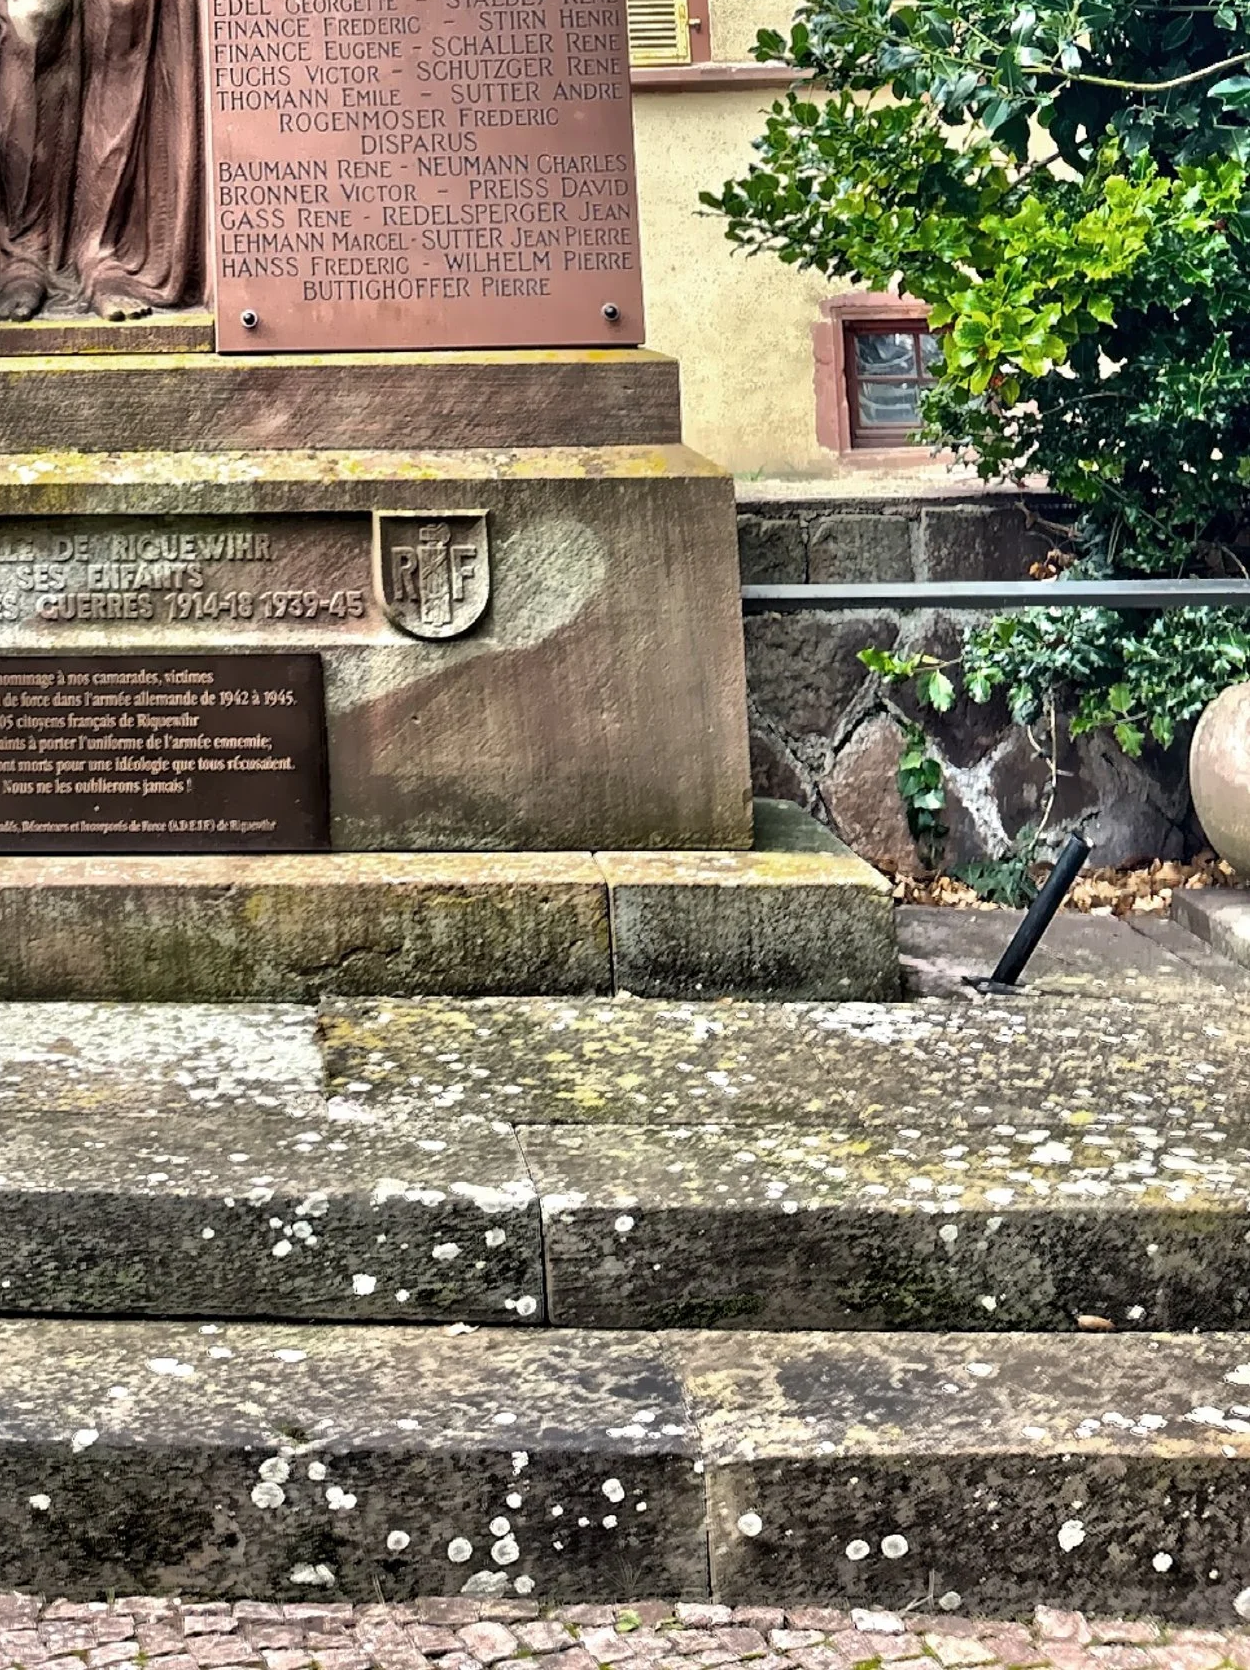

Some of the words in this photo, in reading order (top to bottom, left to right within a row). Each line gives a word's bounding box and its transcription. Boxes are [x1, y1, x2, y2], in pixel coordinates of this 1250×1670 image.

[213, 17, 310, 40] FINANCE
[323, 16, 420, 36] FREDERIC
[479, 9, 545, 31] STIRN
[559, 9, 618, 28] HENRI
[279, 108, 445, 132] ROGENMOSER
[459, 107, 557, 126] FREDERIC
[361, 131, 476, 154] DISPARUS
[219, 160, 327, 182] BAUMANN
[337, 159, 391, 179] RENE
[417, 154, 528, 176] NEUMANN
[537, 153, 626, 174] CHARLES
[220, 208, 284, 230] GASS
[297, 207, 351, 227] RENE
[382, 201, 567, 226] REDELSPERGER
[578, 201, 629, 220] JEAN
[303, 277, 469, 300] BUTTIGHOFFER
[482, 276, 550, 296] PIERRE
[51, 535, 90, 563] DE
[16, 565, 66, 592] SES
[87, 563, 204, 591] ENFANTS
[36, 591, 154, 621] GUERRES
[164, 589, 255, 622] 1914-18
[260, 588, 364, 619] 1939-45
[56, 669, 66, 685] à
[66, 673, 90, 685] nos
[91, 668, 162, 686] camarades,
[162, 668, 214, 684] victimes
[2, 692, 18, 707] de
[20, 691, 50, 707] force
[51, 691, 82, 706] dans
[83, 690, 132, 706] l'armée
[133, 689, 198, 706] allemande
[199, 688, 216, 706] de
[218, 688, 249, 707] 1942
[251, 688, 260, 705] à
[262, 688, 297, 707] 1945.
[15, 713, 66, 732] citoyens
[66, 712, 116, 732] français
[118, 712, 134, 728] de
[136, 711, 200, 731] Riquewihr
[28, 734, 37, 750] à
[38, 736, 77, 753] porter
[78, 733, 144, 750] l'uniforme
[145, 733, 162, 750] de
[163, 732, 212, 749] l'armée
[212, 732, 272, 751] ennemie;
[17, 758, 54, 772] morts
[55, 760, 86, 775] pour
[87, 759, 112, 771] une
[114, 755, 170, 775] idéologie
[171, 759, 196, 775] que
[197, 756, 225, 771] tous
[226, 754, 295, 770] récusaient.
[2, 779, 34, 794] Nous
[35, 781, 53, 794] ne
[54, 777, 72, 794] les
[74, 776, 141, 793] oublierons
[142, 777, 184, 796] jamais
